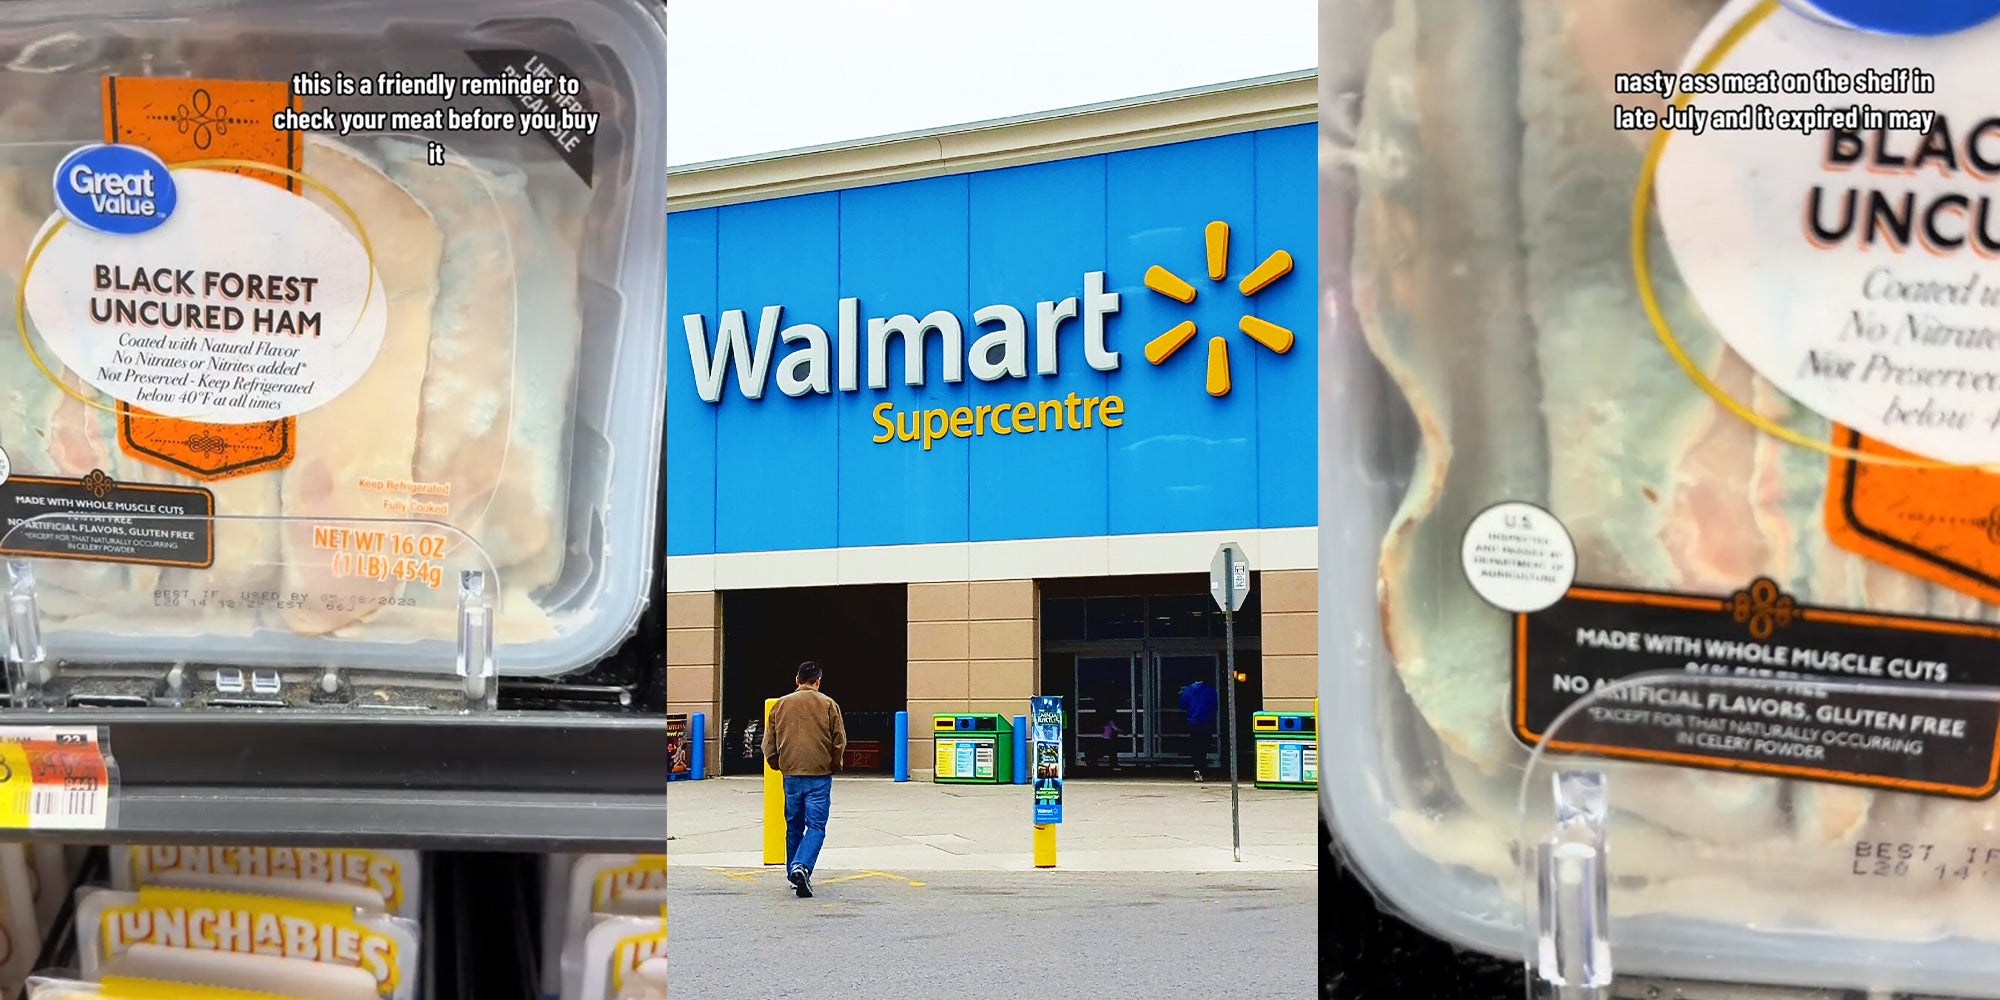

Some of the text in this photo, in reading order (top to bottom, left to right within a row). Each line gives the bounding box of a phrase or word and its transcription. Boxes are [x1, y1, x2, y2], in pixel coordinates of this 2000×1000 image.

[69, 164, 155, 197] Great
[90, 193, 156, 217] Value
[95, 264, 318, 304] BLACK FOREST
[91, 297, 321, 337] UNCURED HAM
[119, 332, 300, 358] Coated with Natural Flavor
[682, 271, 1121, 402] Walmart
[113, 350, 132, 365] No
[135, 352, 189, 369] Nitrates
[189, 359, 205, 369] or
[207, 356, 255, 373] Nitrites
[96, 366, 122, 382] Not
[124, 368, 189, 386] Preserved
[198, 374, 230, 393] Keep
[233, 376, 315, 395] Refrigerated
[136, 386, 175, 403] below
[213, 396, 227, 406] at
[229, 391, 248, 408] all
[248, 395, 281, 410] times
[872, 392, 1125, 451] Supercentre
[358, 479, 449, 495] Keep Refrigerated
[15, 495, 184, 515] MADE WITH WHOLE MUSCLE CUTS
[383, 500, 447, 514] Fully Cooked
[7, 518, 24, 526] NO
[24, 520, 78, 533] ARTIFICIAL
[129, 527, 168, 539] GLUTEN
[170, 531, 195, 541] FREE
[313, 527, 446, 559] NET WT 16 OZ
[333, 553, 442, 591] (1 LB) 454g
[154, 589, 189, 599] BEST
[203, 590, 219, 599] IF
[241, 591, 279, 601] USED
[291, 592, 308, 602] BY
[1576, 627, 1948, 682] MADE WITH WHOLE MUSCLE CUTS
[1553, 673, 1590, 694] NO
[1815, 704, 1906, 732] GLUTEN
[1910, 715, 1967, 739] FREE
[1687, 714, 1728, 731] THAT
[1729, 718, 1820, 743] NATURALLY
[1821, 729, 1924, 756] OCCURRING
[1754, 738, 1826, 760] POWDER
[1854, 841, 1935, 860] BEST
